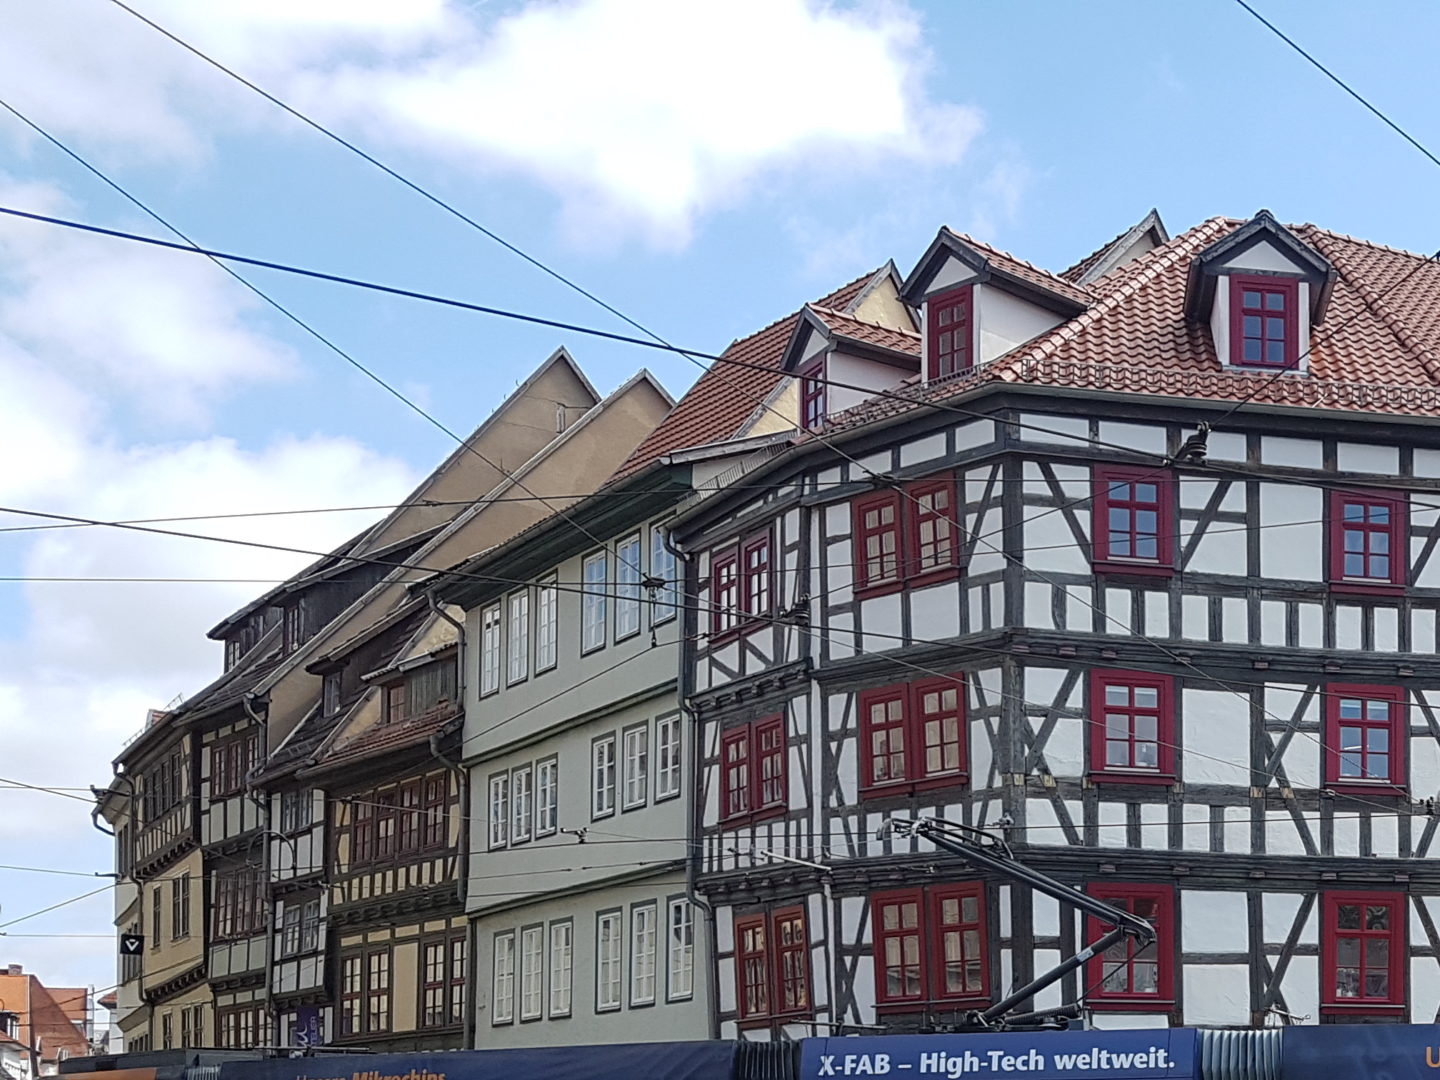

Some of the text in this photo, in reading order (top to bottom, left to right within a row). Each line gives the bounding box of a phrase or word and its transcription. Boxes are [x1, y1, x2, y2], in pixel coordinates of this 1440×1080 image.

[817, 1052, 891, 1077] X-FAB
[919, 1049, 1045, 1079] High-Tech
[1054, 1046, 1175, 1071] weltweit.
